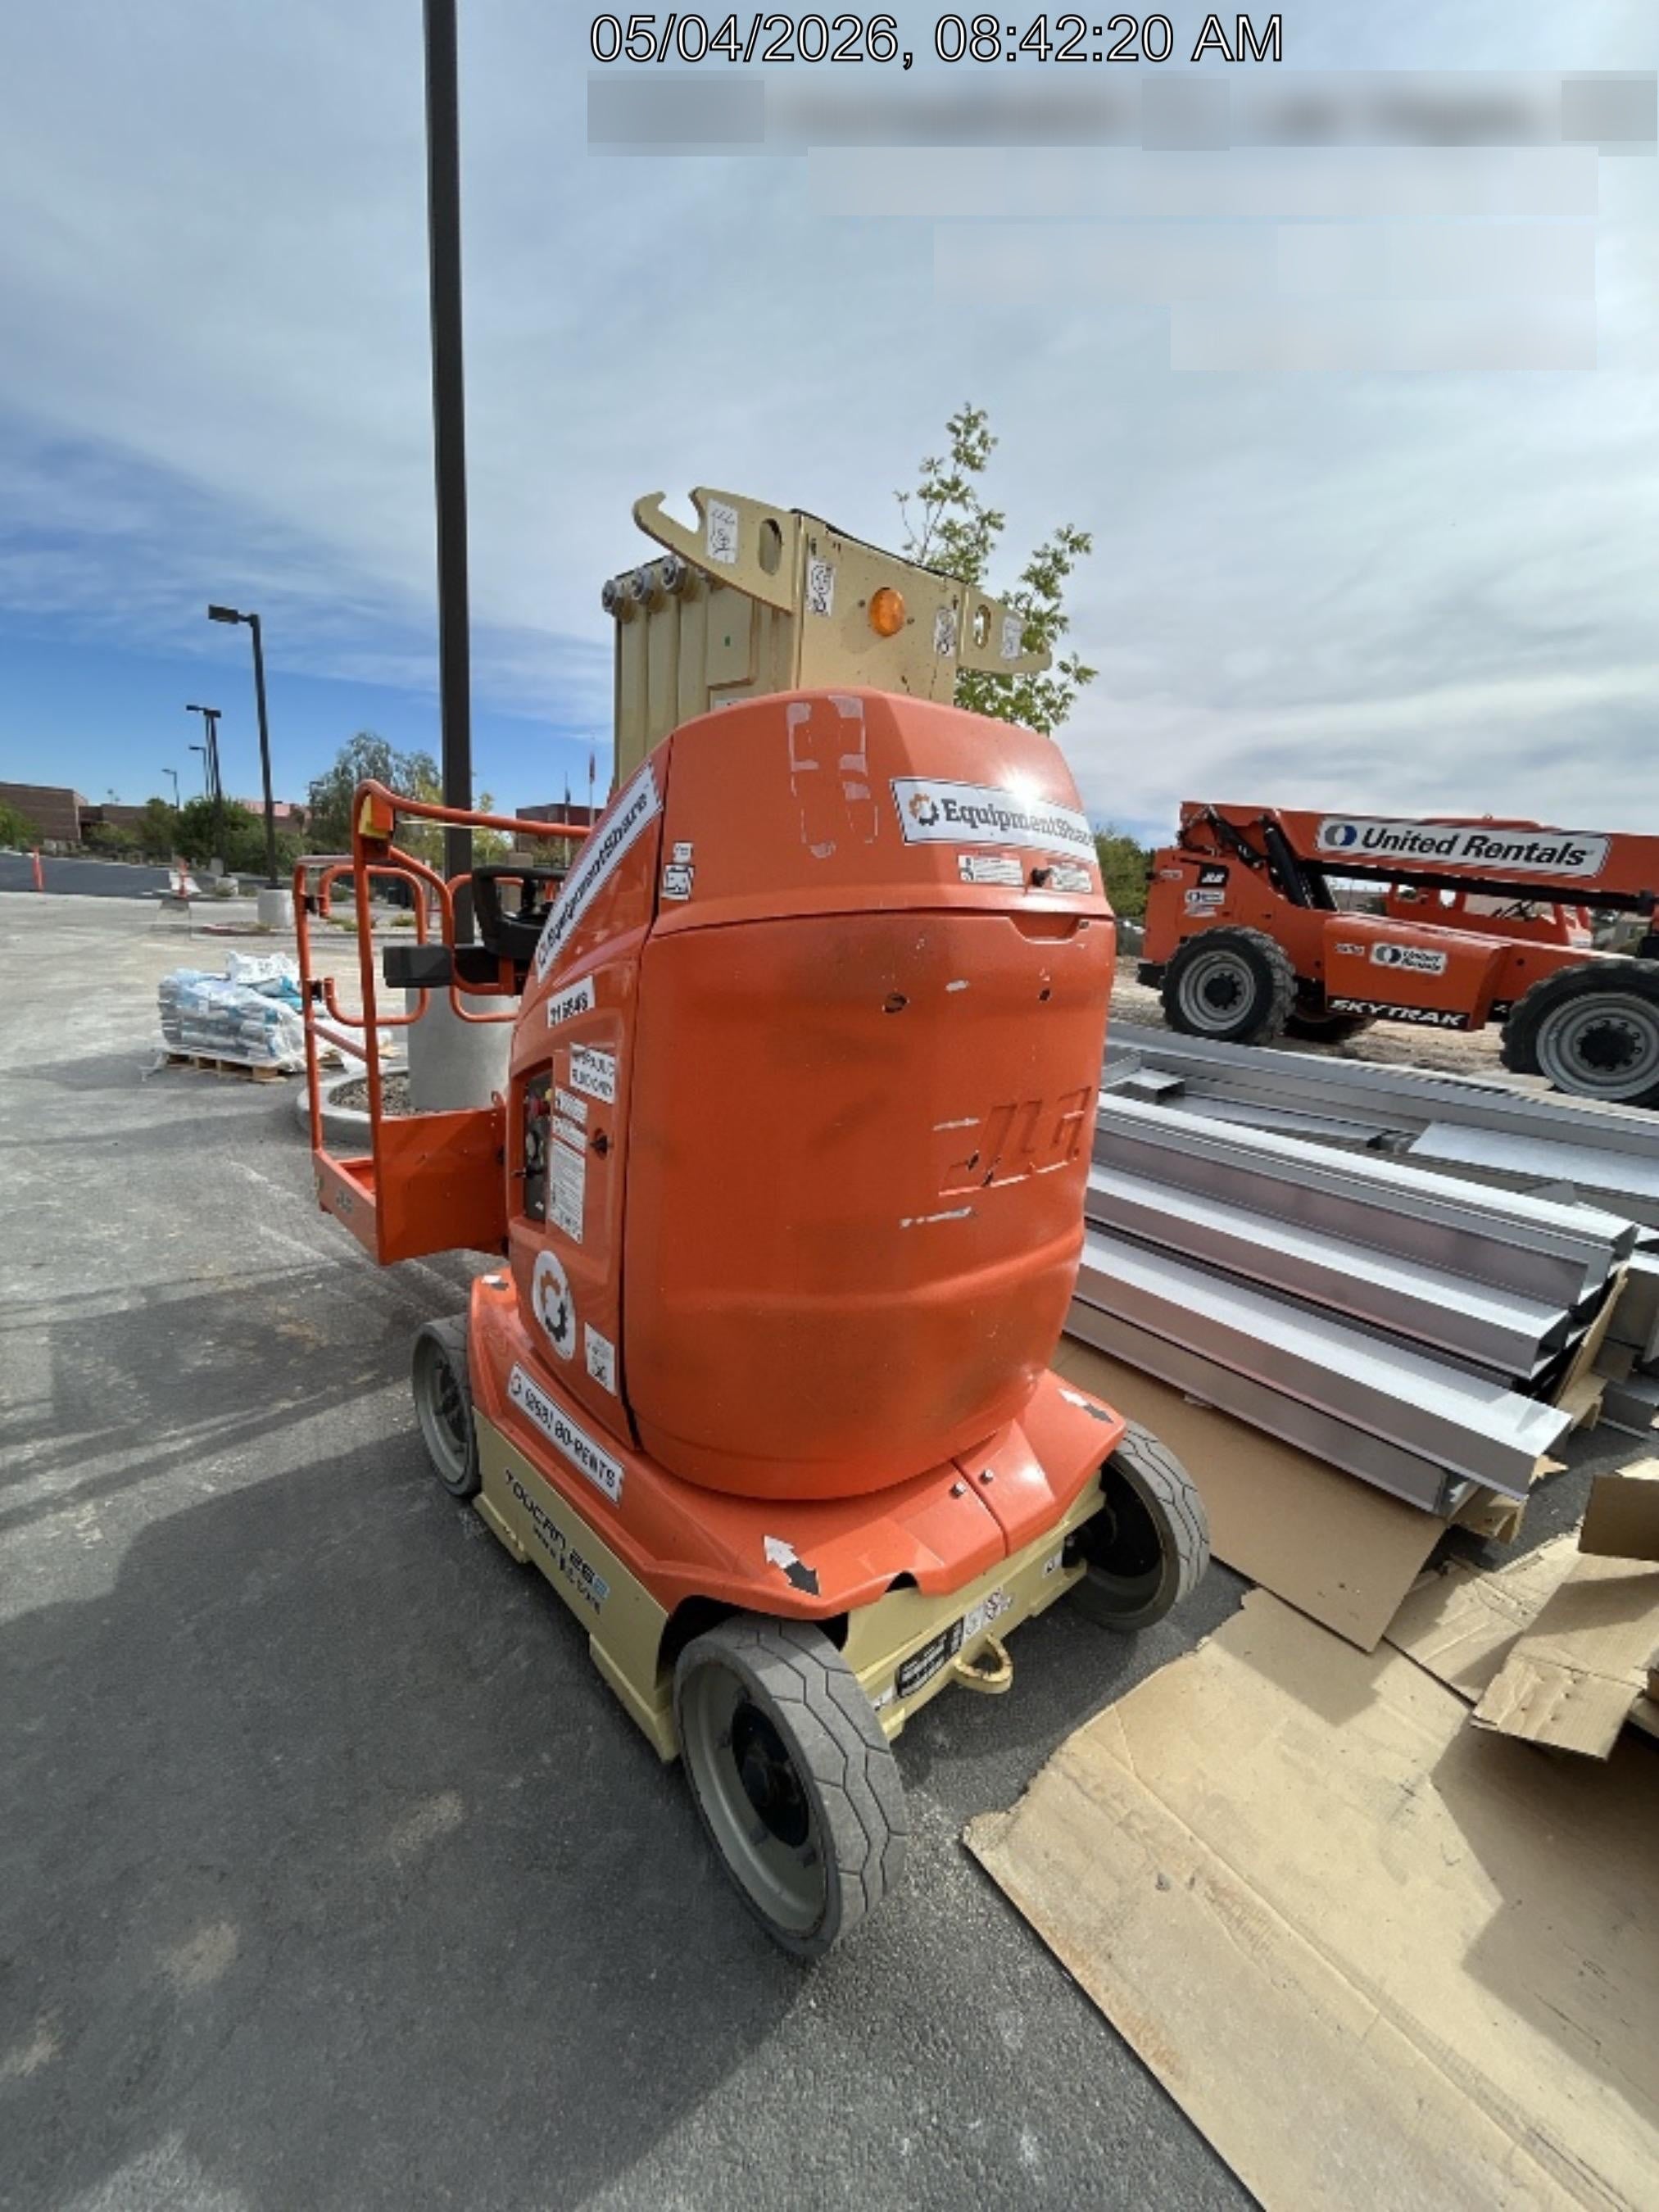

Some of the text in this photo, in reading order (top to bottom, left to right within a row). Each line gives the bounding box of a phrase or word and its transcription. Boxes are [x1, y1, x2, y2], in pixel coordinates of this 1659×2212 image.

[1361, 827, 1589, 867] United Rentals
[1330, 999, 1466, 1027] SKYTRAK
